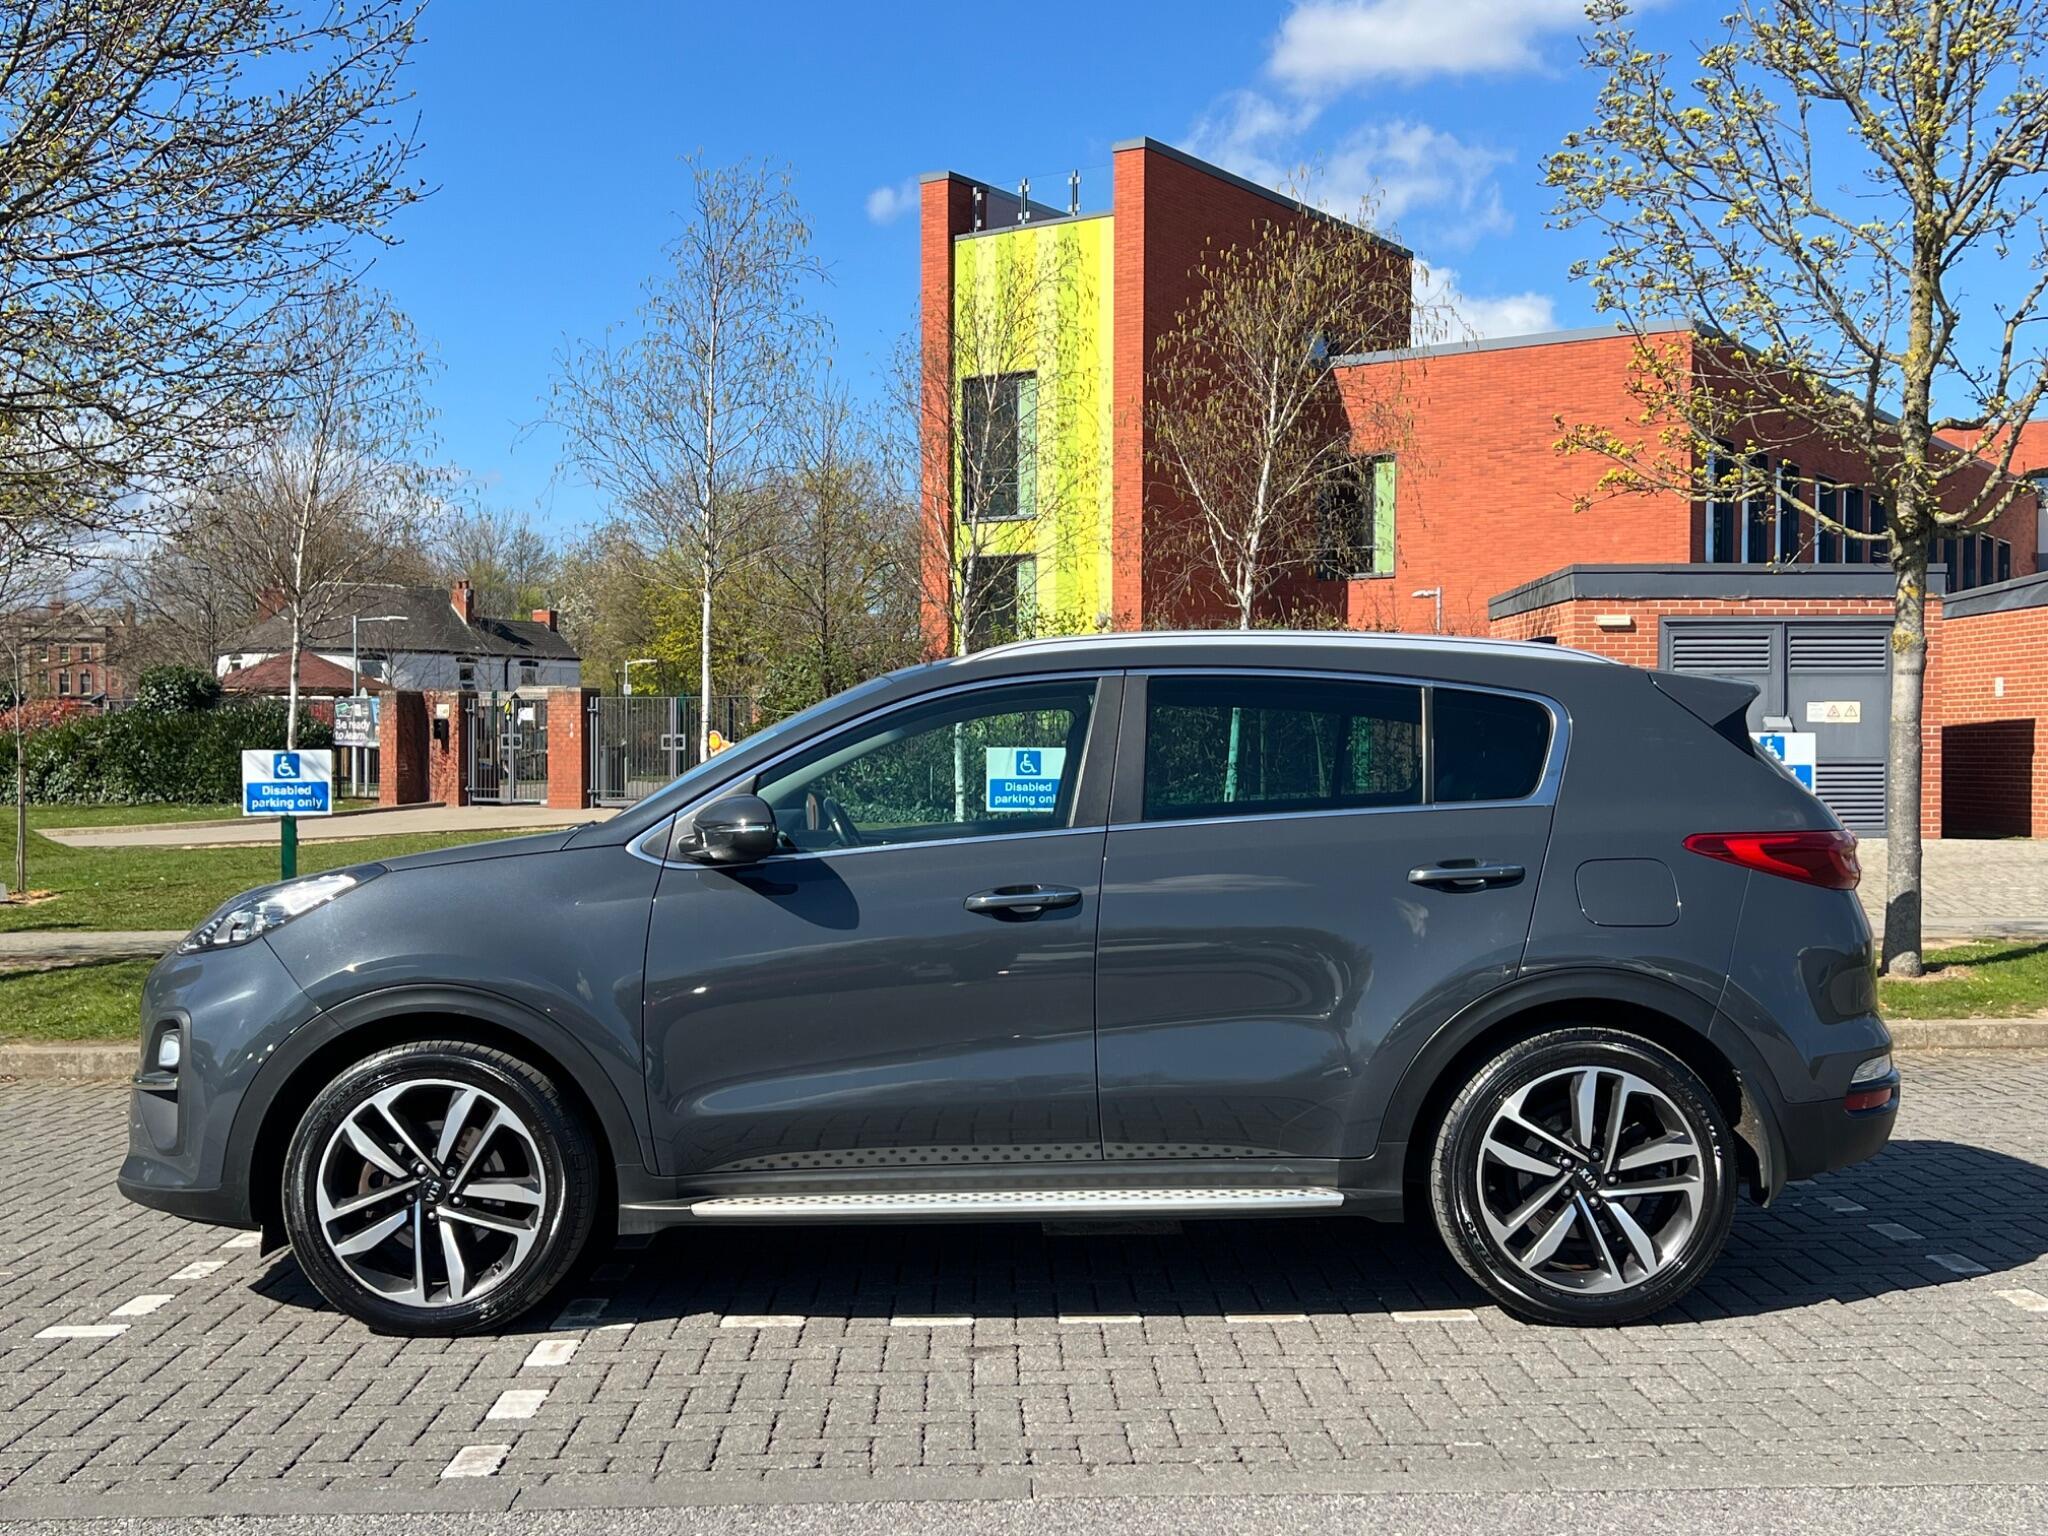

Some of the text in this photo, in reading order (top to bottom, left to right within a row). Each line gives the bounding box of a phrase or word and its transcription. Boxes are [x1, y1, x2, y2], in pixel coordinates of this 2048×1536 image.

[336, 719, 371, 732] Be ready
[335, 730, 345, 740] to
[261, 785, 312, 796] Disabled
[1005, 781, 1052, 792] Disabled
[251, 797, 323, 810] parking only
[994, 793, 1056, 806] parking onl
[1579, 1168, 1597, 1189] KIA
[425, 1180, 442, 1202] KIA
